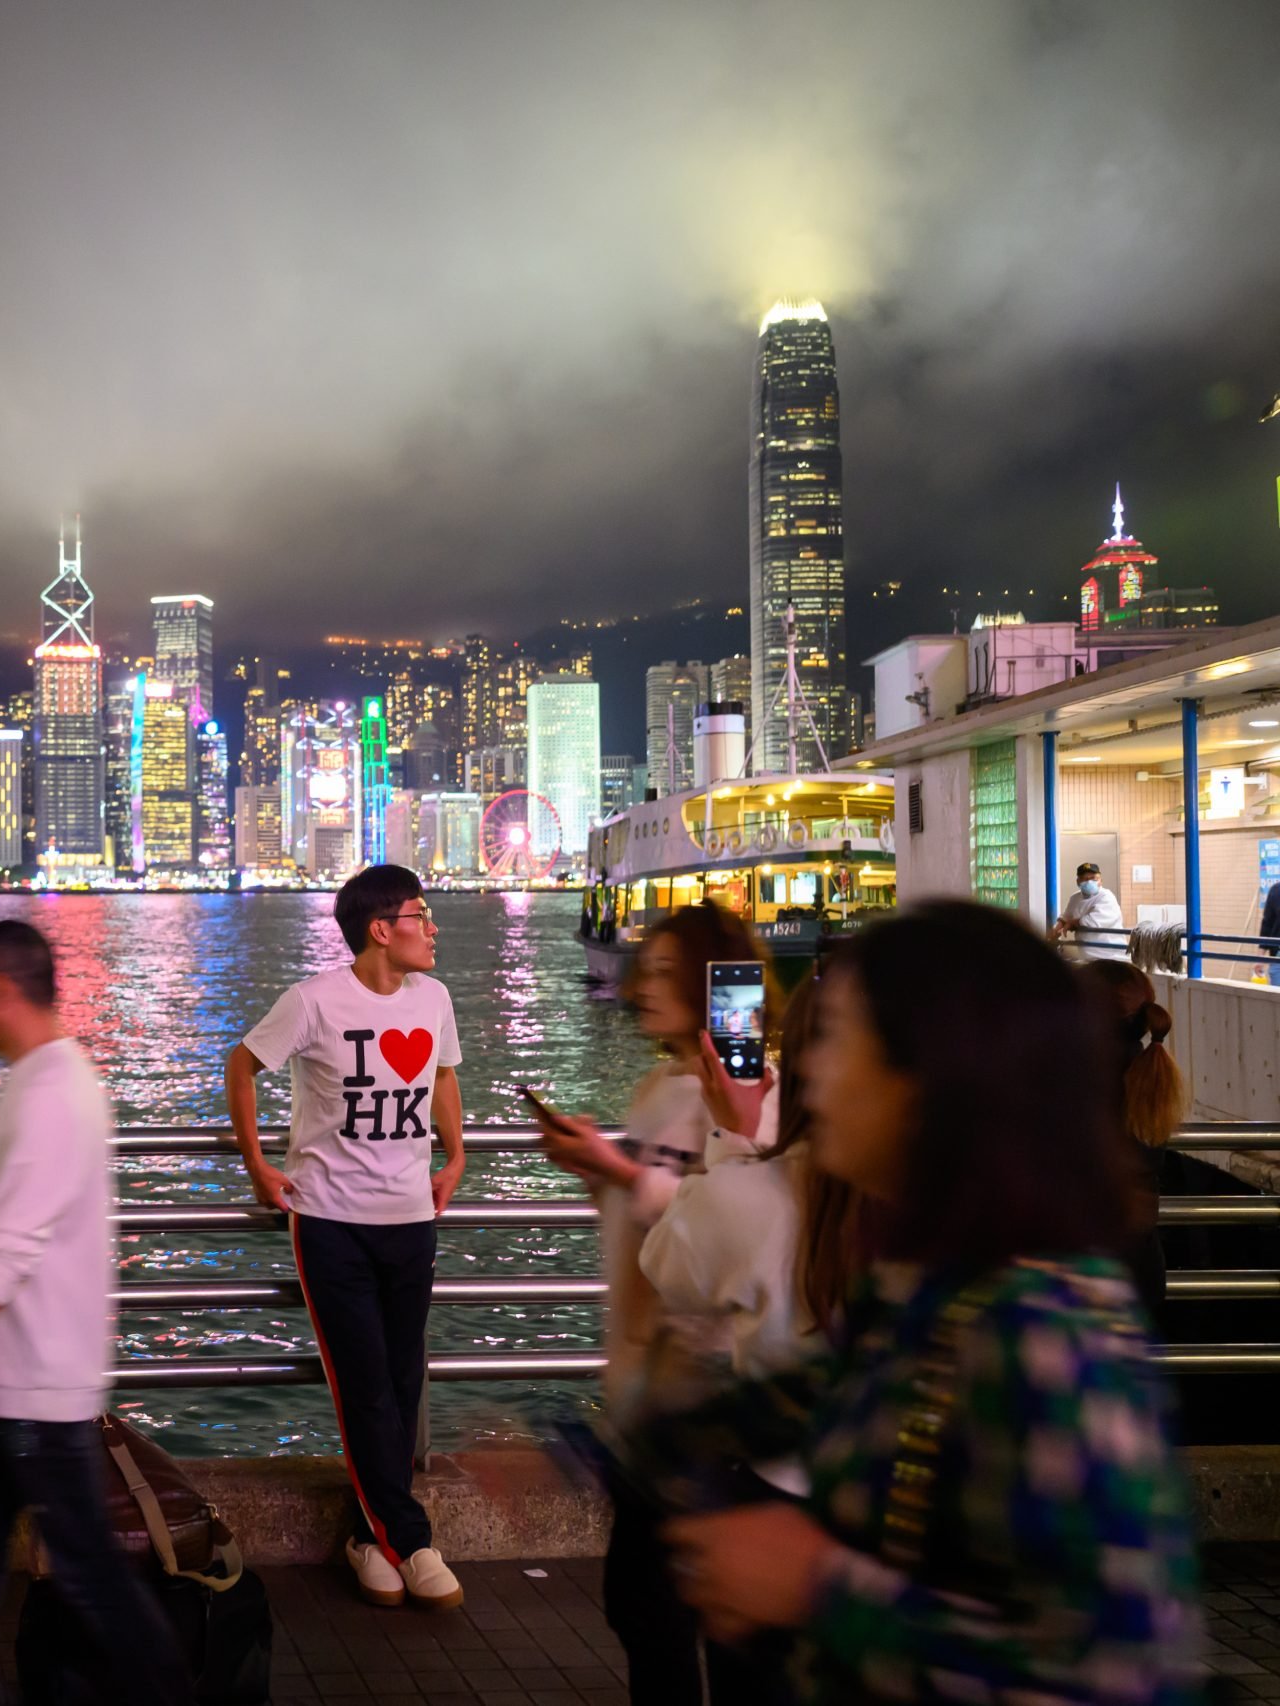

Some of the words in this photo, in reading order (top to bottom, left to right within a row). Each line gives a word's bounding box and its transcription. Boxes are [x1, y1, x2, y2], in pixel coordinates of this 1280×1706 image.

[773, 922, 801, 936] A5243
[343, 1029, 375, 1087] I
[339, 1087, 429, 1141] HK
